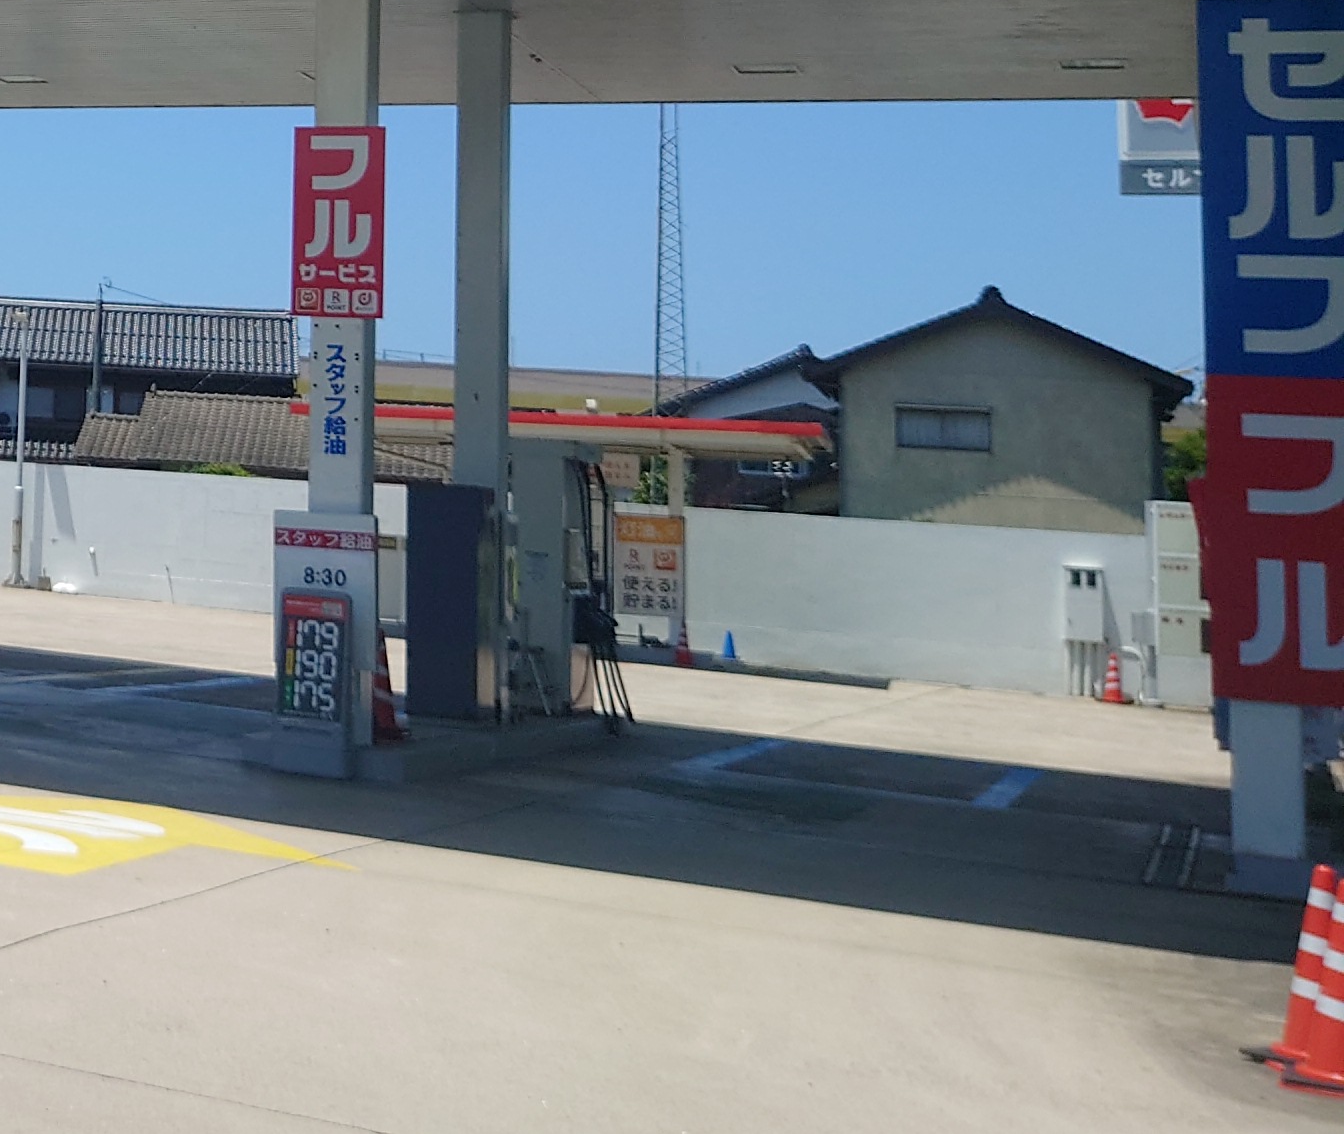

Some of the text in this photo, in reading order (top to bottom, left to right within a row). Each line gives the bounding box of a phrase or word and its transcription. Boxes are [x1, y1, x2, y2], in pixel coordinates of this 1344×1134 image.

[1141, 168, 1201, 189] セル
[1227, 17, 1344, 355] セルフ
[304, 135, 372, 259] フル
[298, 263, 377, 283] サービス
[323, 344, 347, 455] スタッフ給油
[276, 528, 375, 550] スタッフ給油
[1238, 412, 1344, 672] フル
[303, 566, 347, 587] 8:30
[296, 618, 340, 650] 179
[295, 649, 338, 681] 190
[293, 679, 336, 712] 175
